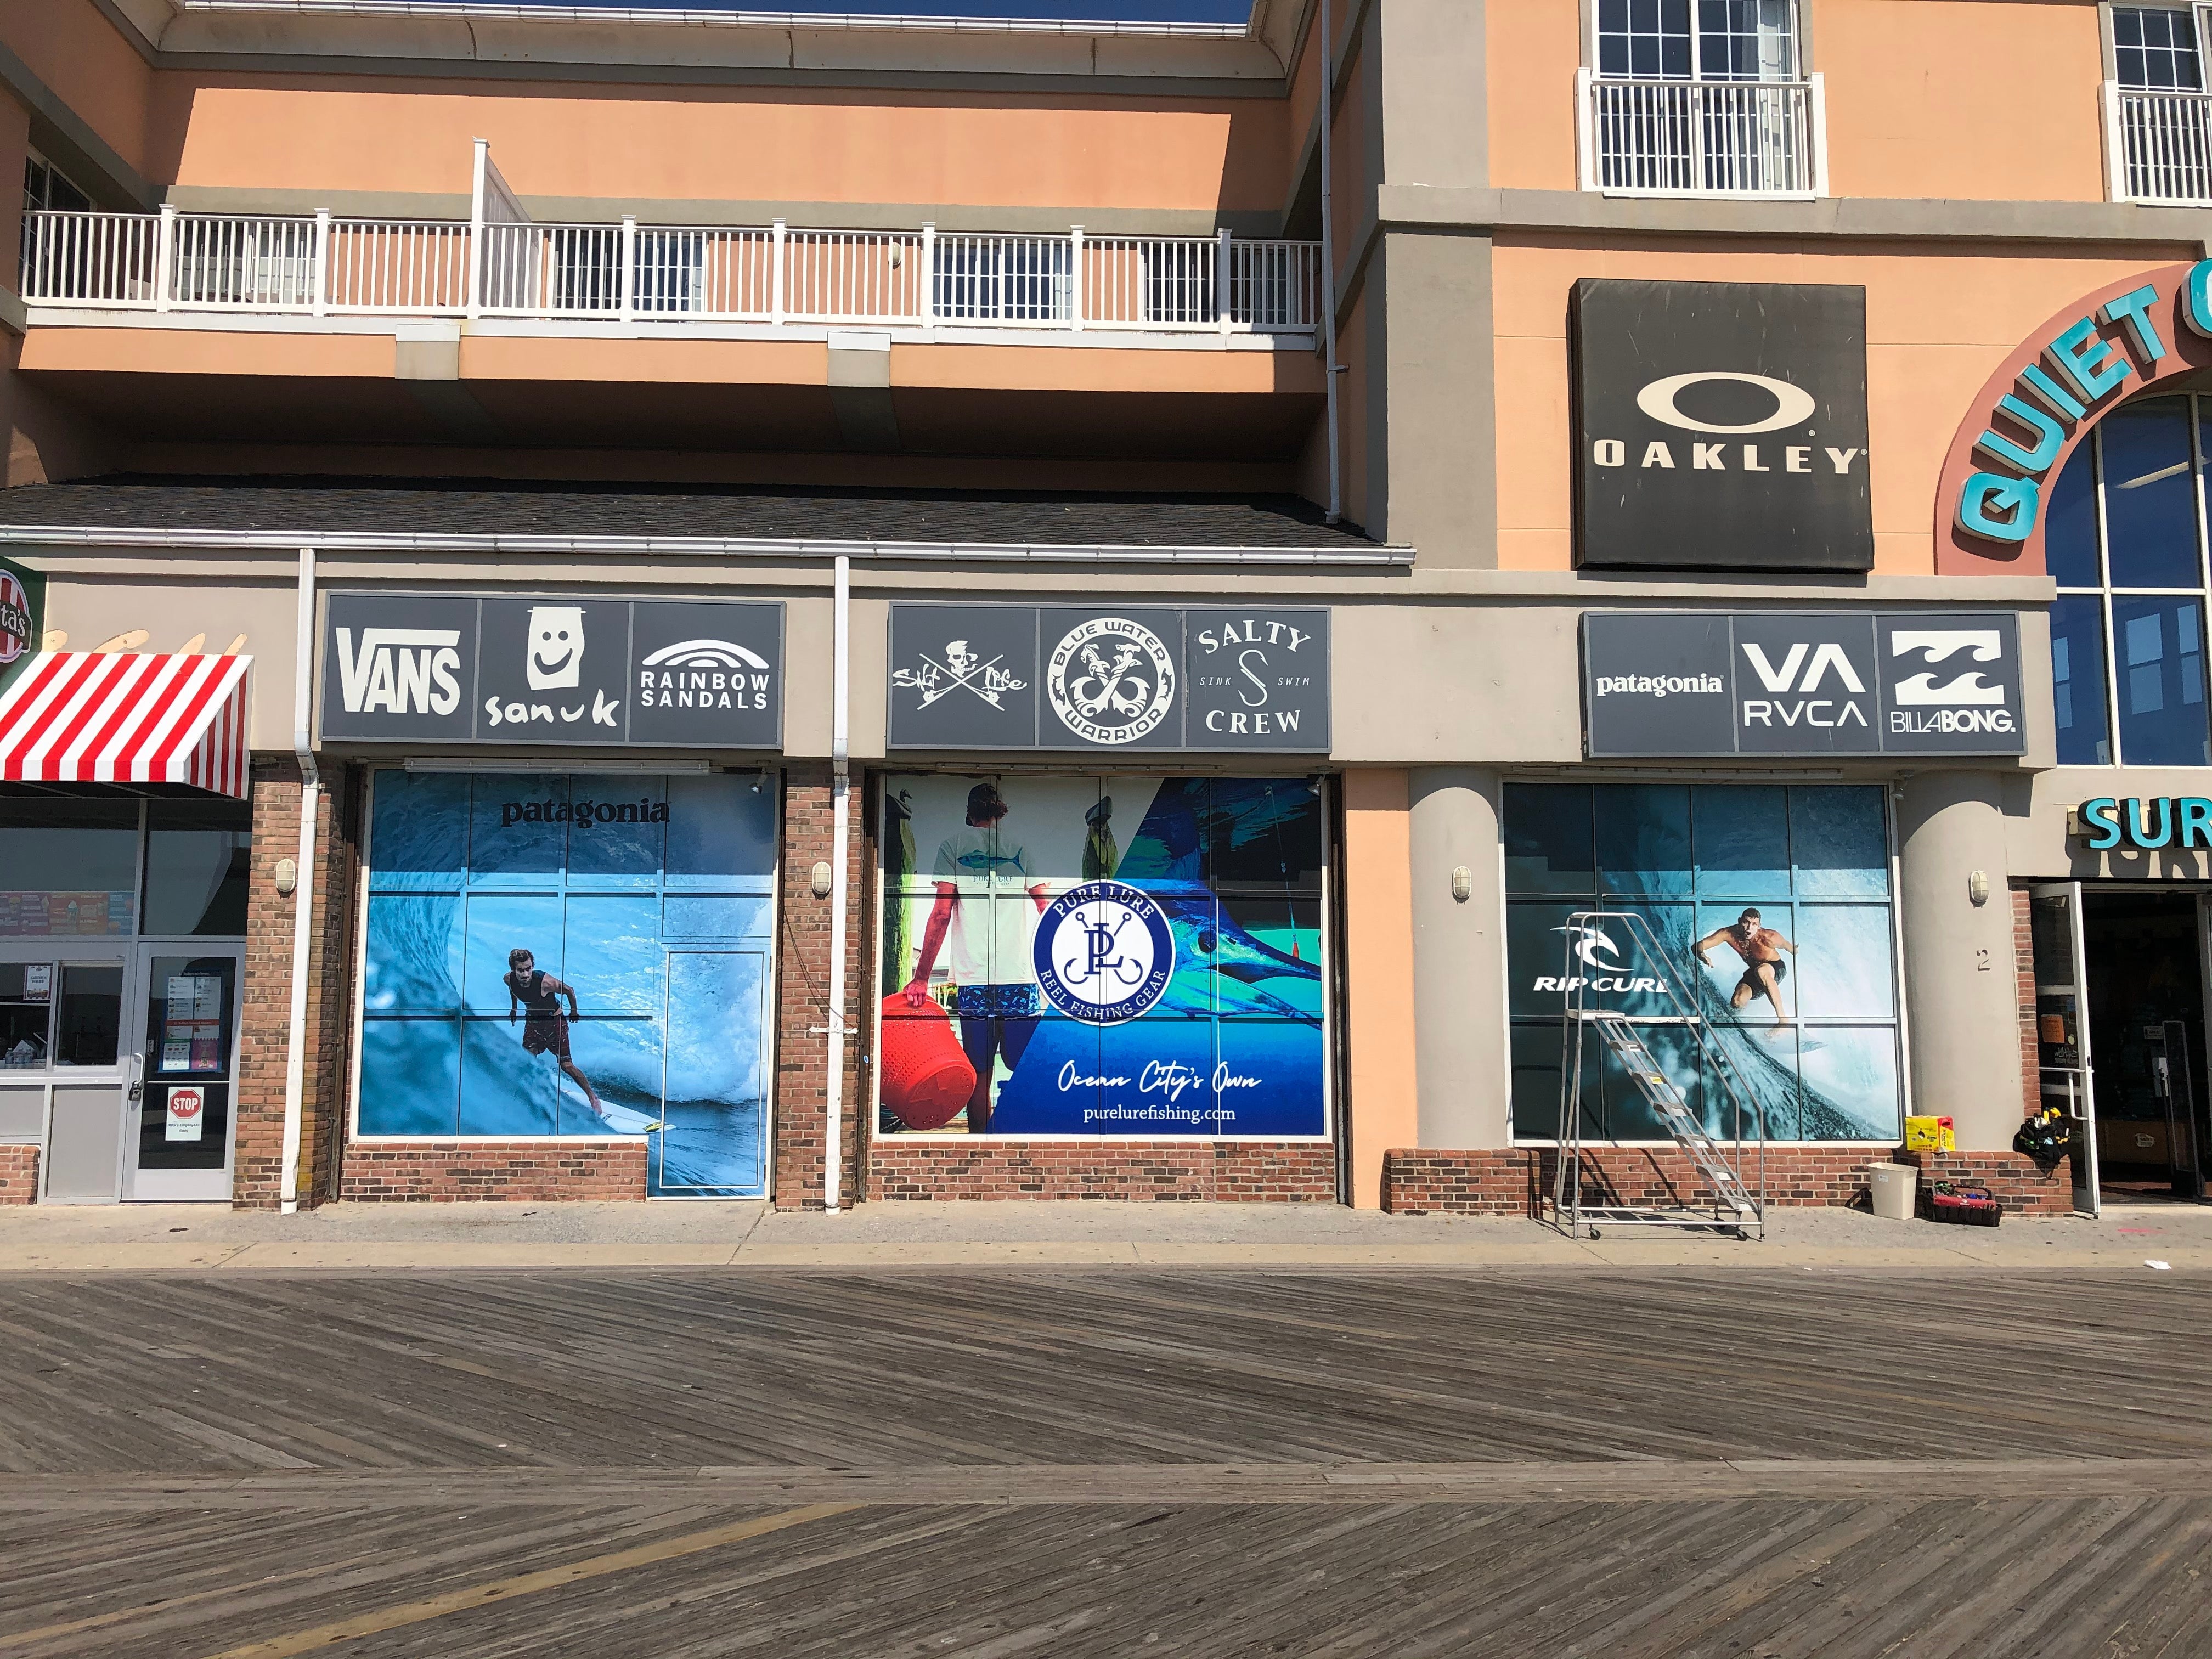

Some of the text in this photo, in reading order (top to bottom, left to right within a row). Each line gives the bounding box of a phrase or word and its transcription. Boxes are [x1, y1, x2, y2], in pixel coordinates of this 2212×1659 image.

[1954, 284, 2167, 543] QUIET
[1593, 439, 1859, 474] OAKLEY
[1053, 621, 1166, 666] BLUE WATER
[1198, 619, 1311, 654] SALTY
[335, 627, 461, 715] VANS
[641, 671, 770, 691] RAINBOW
[1199, 676, 1310, 686] SINK SWIM
[1596, 673, 1723, 697] patagonia
[484, 689, 620, 727] sanuk
[640, 690, 768, 710] SANDALS
[1743, 700, 1869, 727] RVCA
[1064, 708, 1163, 741] WARRIOR
[1206, 709, 1301, 734] CREW
[501, 798, 670, 830] patagonia
[2078, 797, 2212, 849] SUR
[1053, 885, 1155, 919] PURE LURE
[1040, 969, 1166, 1020] REEL FISHING GEAR
[1533, 977, 1672, 993] RIP CURL
[1058, 1059, 1262, 1102] Ocean City's Own
[173, 1097, 199, 1110] STOP
[1083, 1104, 1236, 1124] purelurefishing.com
